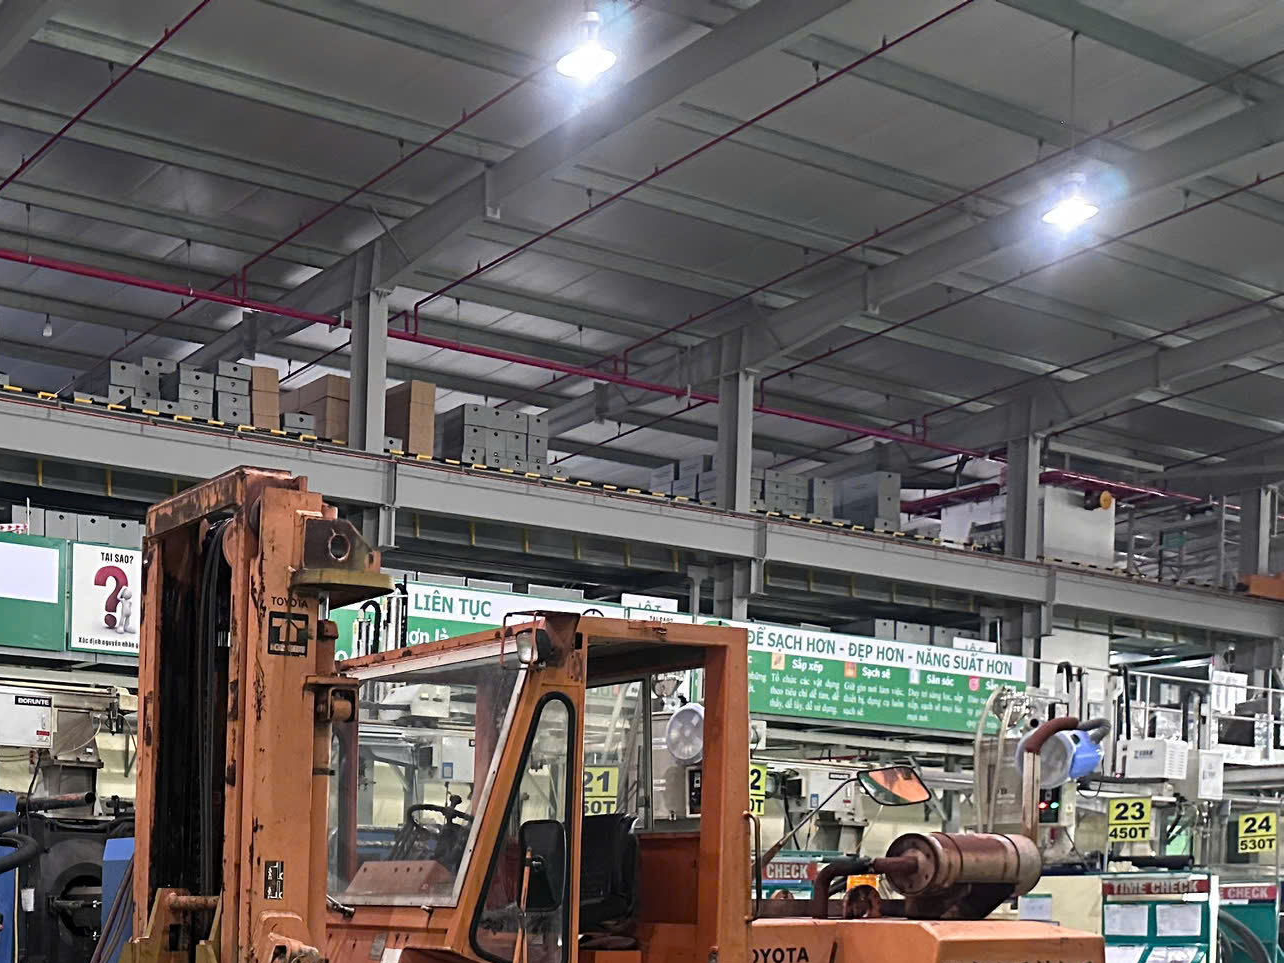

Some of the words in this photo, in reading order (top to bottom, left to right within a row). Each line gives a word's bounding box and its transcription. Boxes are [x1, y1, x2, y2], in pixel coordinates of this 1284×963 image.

[114, 554, 134, 564] SAO?
[271, 596, 308, 609] TOYOTA
[414, 590, 453, 614] LIÊN
[459, 598, 492, 620] TỤC
[768, 632, 802, 652] SẠCH
[807, 637, 835, 654] HƠN
[848, 642, 873, 662] ĐẸP
[876, 645, 904, 663] HƠN
[916, 648, 950, 668] NĂNG
[953, 653, 984, 672] SUẤT
[986, 659, 1012, 675] HƠN
[1115, 802, 1145, 820] 23
[1244, 816, 1272, 834] 24
[1109, 826, 1149, 841] 450T
[1240, 838, 1276, 851] 530T
[766, 863, 808, 879] CHECK
[1113, 882, 1147, 894] TIME
[1150, 880, 1198, 893] CHECK
[1228, 887, 1268, 899] CHECK
